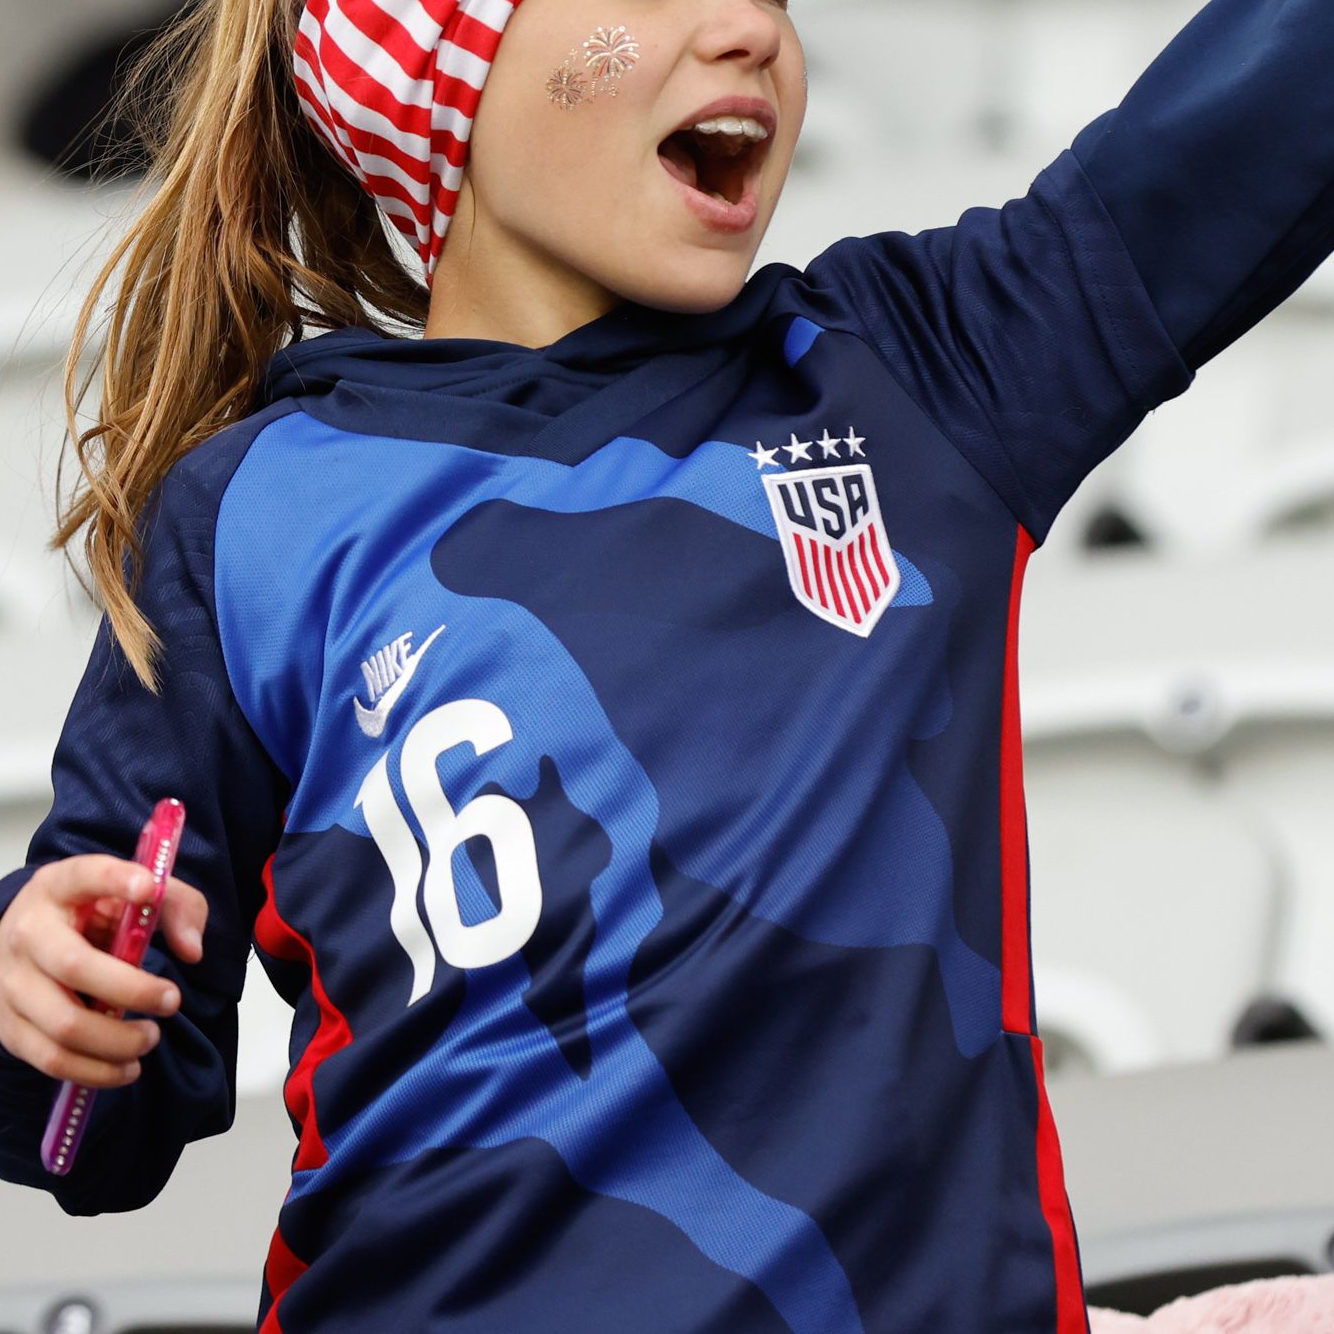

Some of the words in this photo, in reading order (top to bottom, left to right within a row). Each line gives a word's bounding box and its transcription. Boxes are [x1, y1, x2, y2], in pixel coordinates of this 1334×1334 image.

[777, 473, 869, 541] USA
[360, 631, 414, 703] NIKE
[353, 698, 543, 1007] 16
